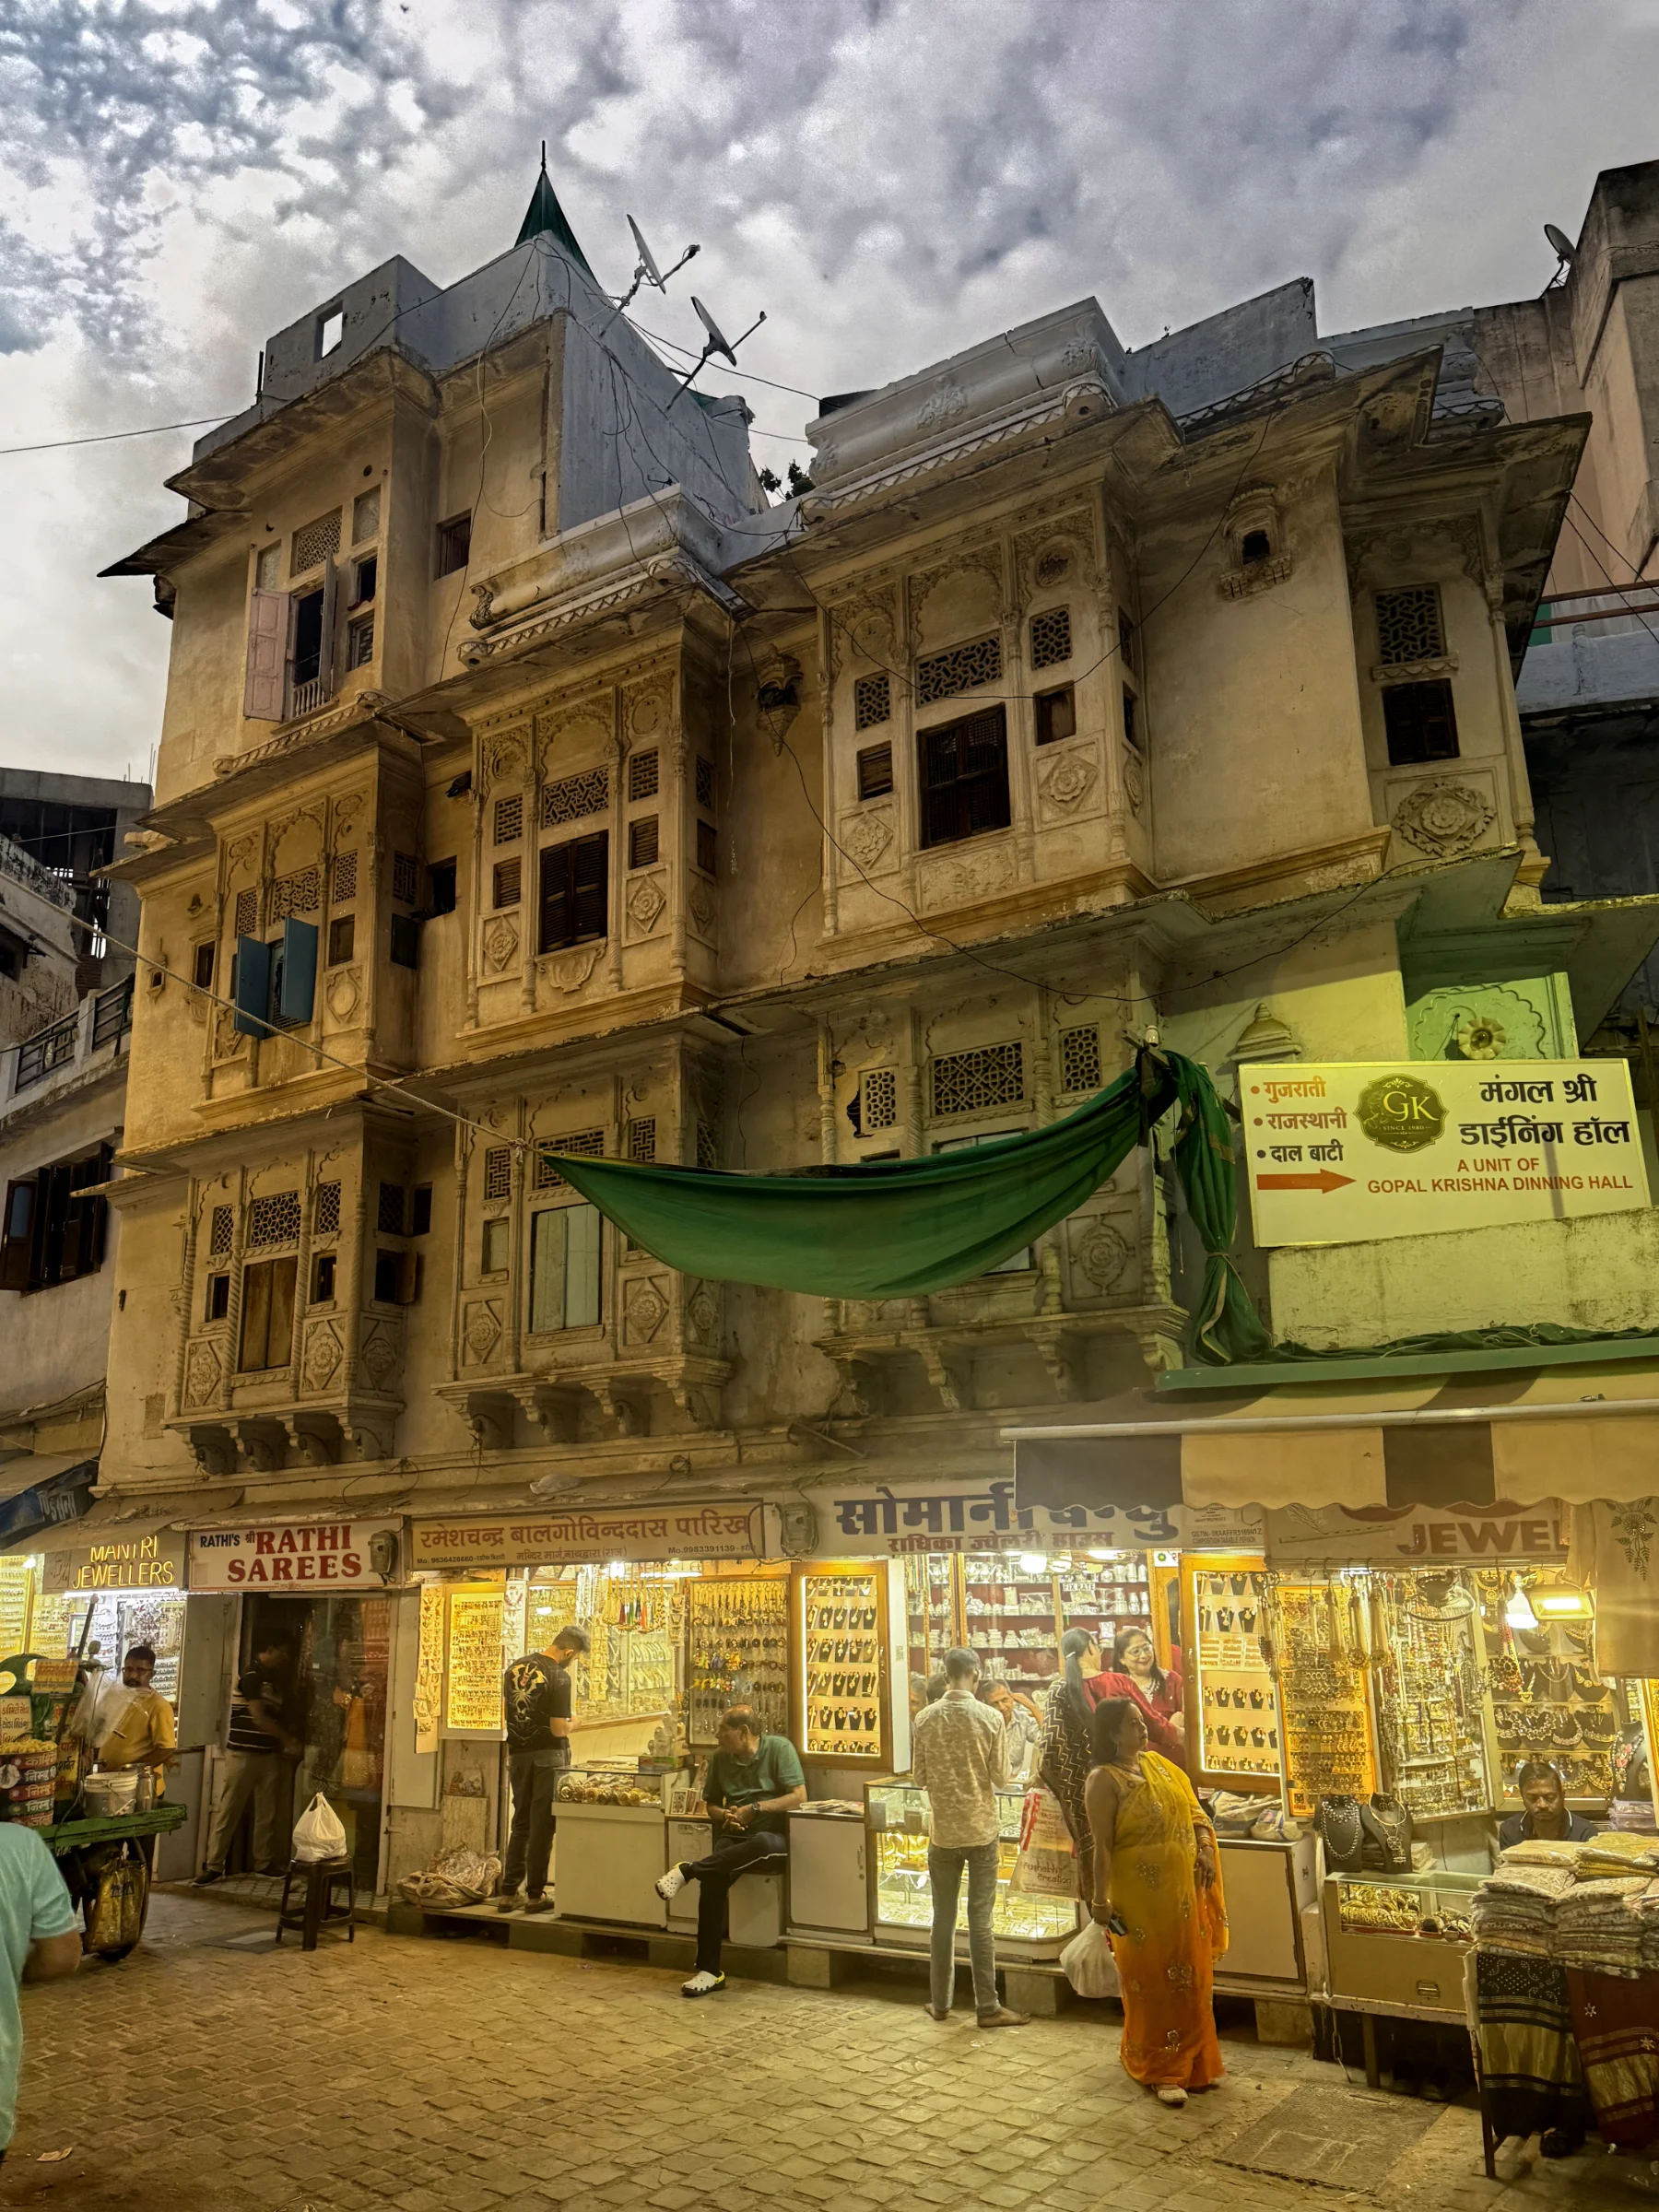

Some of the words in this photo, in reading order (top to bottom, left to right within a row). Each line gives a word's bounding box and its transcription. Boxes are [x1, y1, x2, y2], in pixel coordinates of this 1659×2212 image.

[1264, 1076, 1325, 1103] गुजराती
[1479, 1074, 1553, 1103] मंगल
[1562, 1073, 1596, 1103] श्री
[1266, 1106, 1347, 1130] राजस्थानी
[1382, 1091, 1440, 1122] GK
[1458, 1114, 1564, 1148] डाईनिंग
[1572, 1116, 1630, 1146] हॉल
[1269, 1145, 1302, 1162] दाल
[1308, 1138, 1344, 1162] बाटी
[1457, 1159, 1470, 1172] A
[1473, 1159, 1512, 1172] UNIT
[1517, 1158, 1539, 1171] OF
[1368, 1179, 1428, 1194] GOPAL
[1431, 1178, 1510, 1192] KRISHNA
[1513, 1177, 1583, 1191] DINNING
[1588, 1175, 1633, 1189] HALL
[200, 1534, 241, 1547] RATHI'S
[255, 1525, 351, 1555] RATHI
[420, 1524, 505, 1548] रमेशचन्द्र
[510, 1513, 668, 1544] बालगोविन्ददास
[675, 1508, 749, 1536] पारिख
[888, 1533, 963, 1553] राधिका
[73, 1561, 174, 1589] JEWELLERS
[228, 1553, 361, 1583] SAREES
